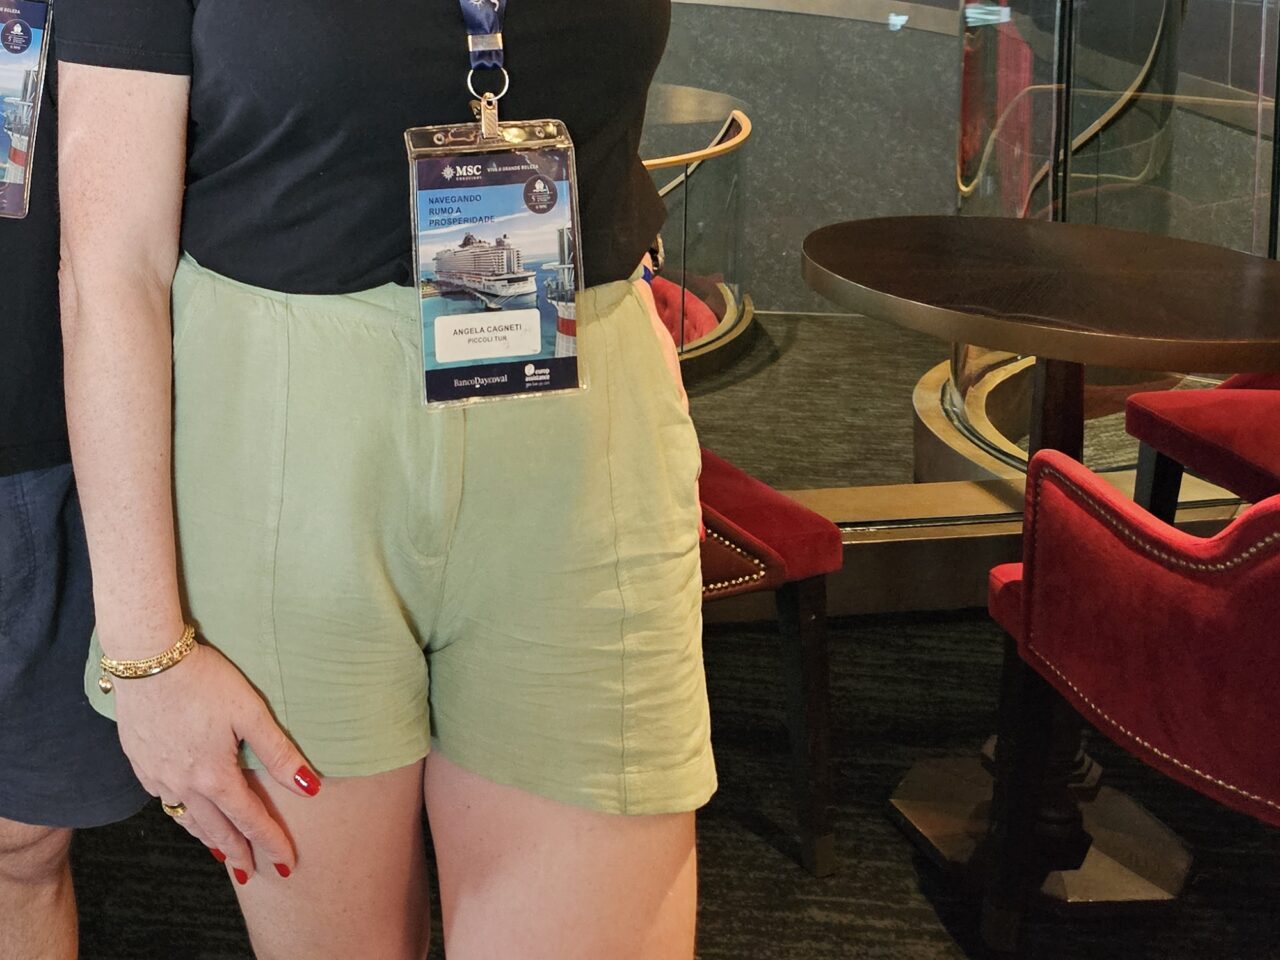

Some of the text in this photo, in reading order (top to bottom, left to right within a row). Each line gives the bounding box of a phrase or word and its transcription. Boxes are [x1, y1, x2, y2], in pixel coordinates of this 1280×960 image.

[455, 165, 482, 177] MSC
[428, 194, 482, 205] NAVEGANDO
[429, 206, 462, 216] RUMO A
[429, 215, 495, 227] PROSPERIDADE
[453, 323, 522, 336] ANGELA CAGNETI
